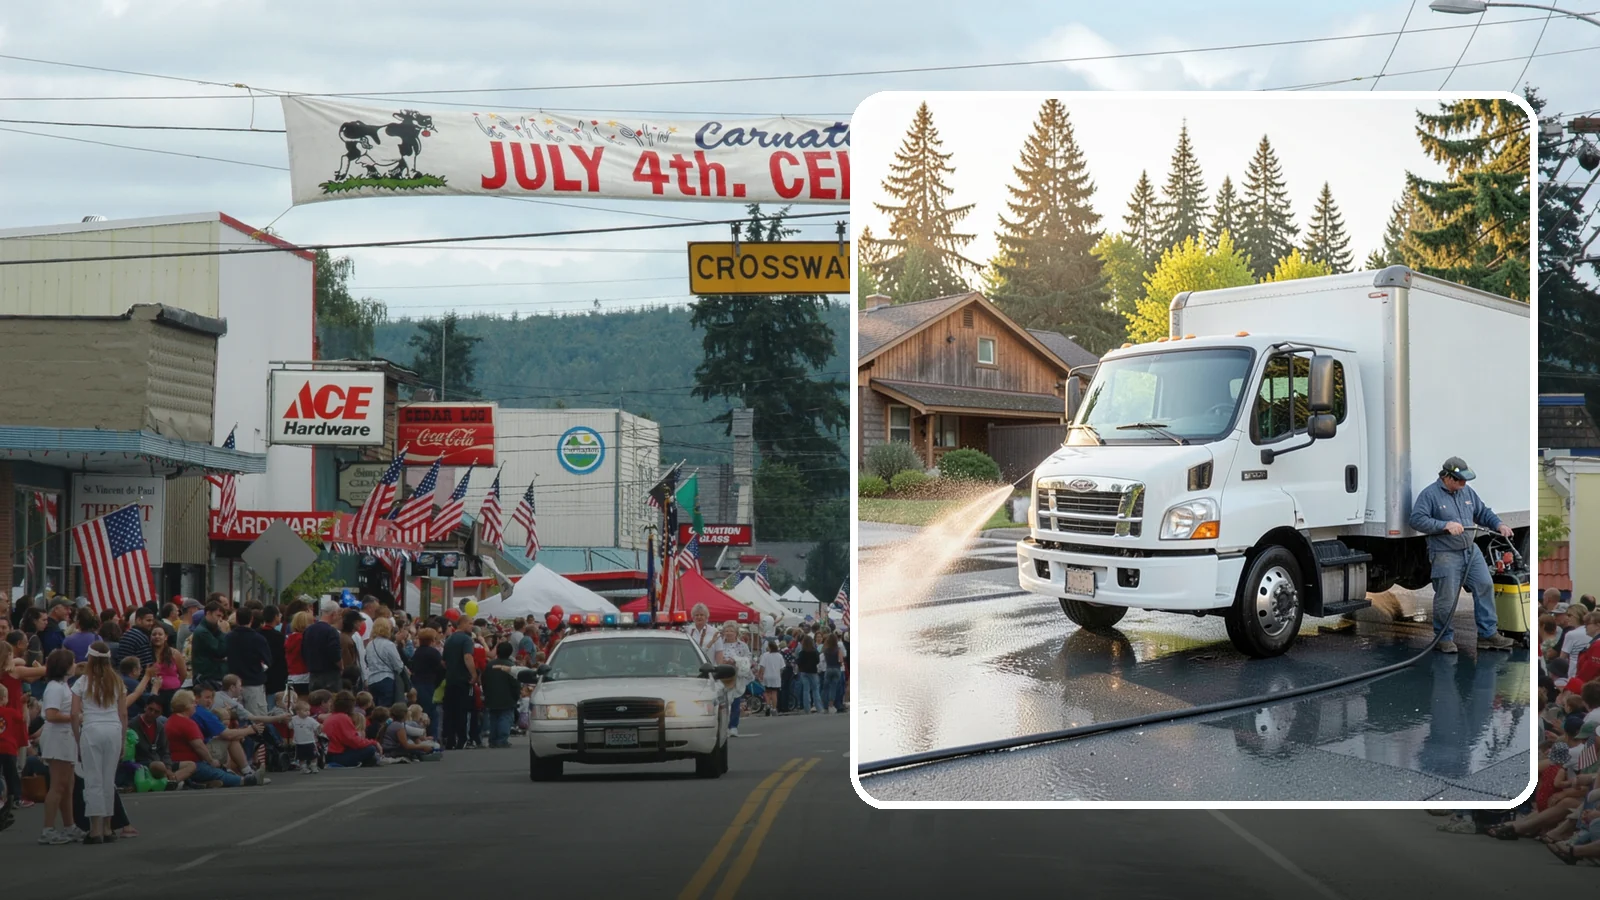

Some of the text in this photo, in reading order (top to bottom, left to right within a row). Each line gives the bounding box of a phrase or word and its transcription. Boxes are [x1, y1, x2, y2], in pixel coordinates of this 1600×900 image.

[481, 140, 605, 192] JULY
[632, 150, 747, 198] 4th.
[697, 254, 850, 280] CROSSWA
[283, 380, 373, 420] ACE
[405, 409, 485, 423] CEDAR LOG
[283, 421, 371, 436] Hardware
[416, 428, 477, 447] Coca-Cola
[353, 467, 384, 480] Simpl
[96, 485, 124, 494] Vincent
[126, 486, 136, 495] de
[138, 486, 155, 495] Paul
[212, 517, 331, 536] HARDARE
[688, 526, 741, 535] CRNATION
[699, 535, 730, 543] GLASS
